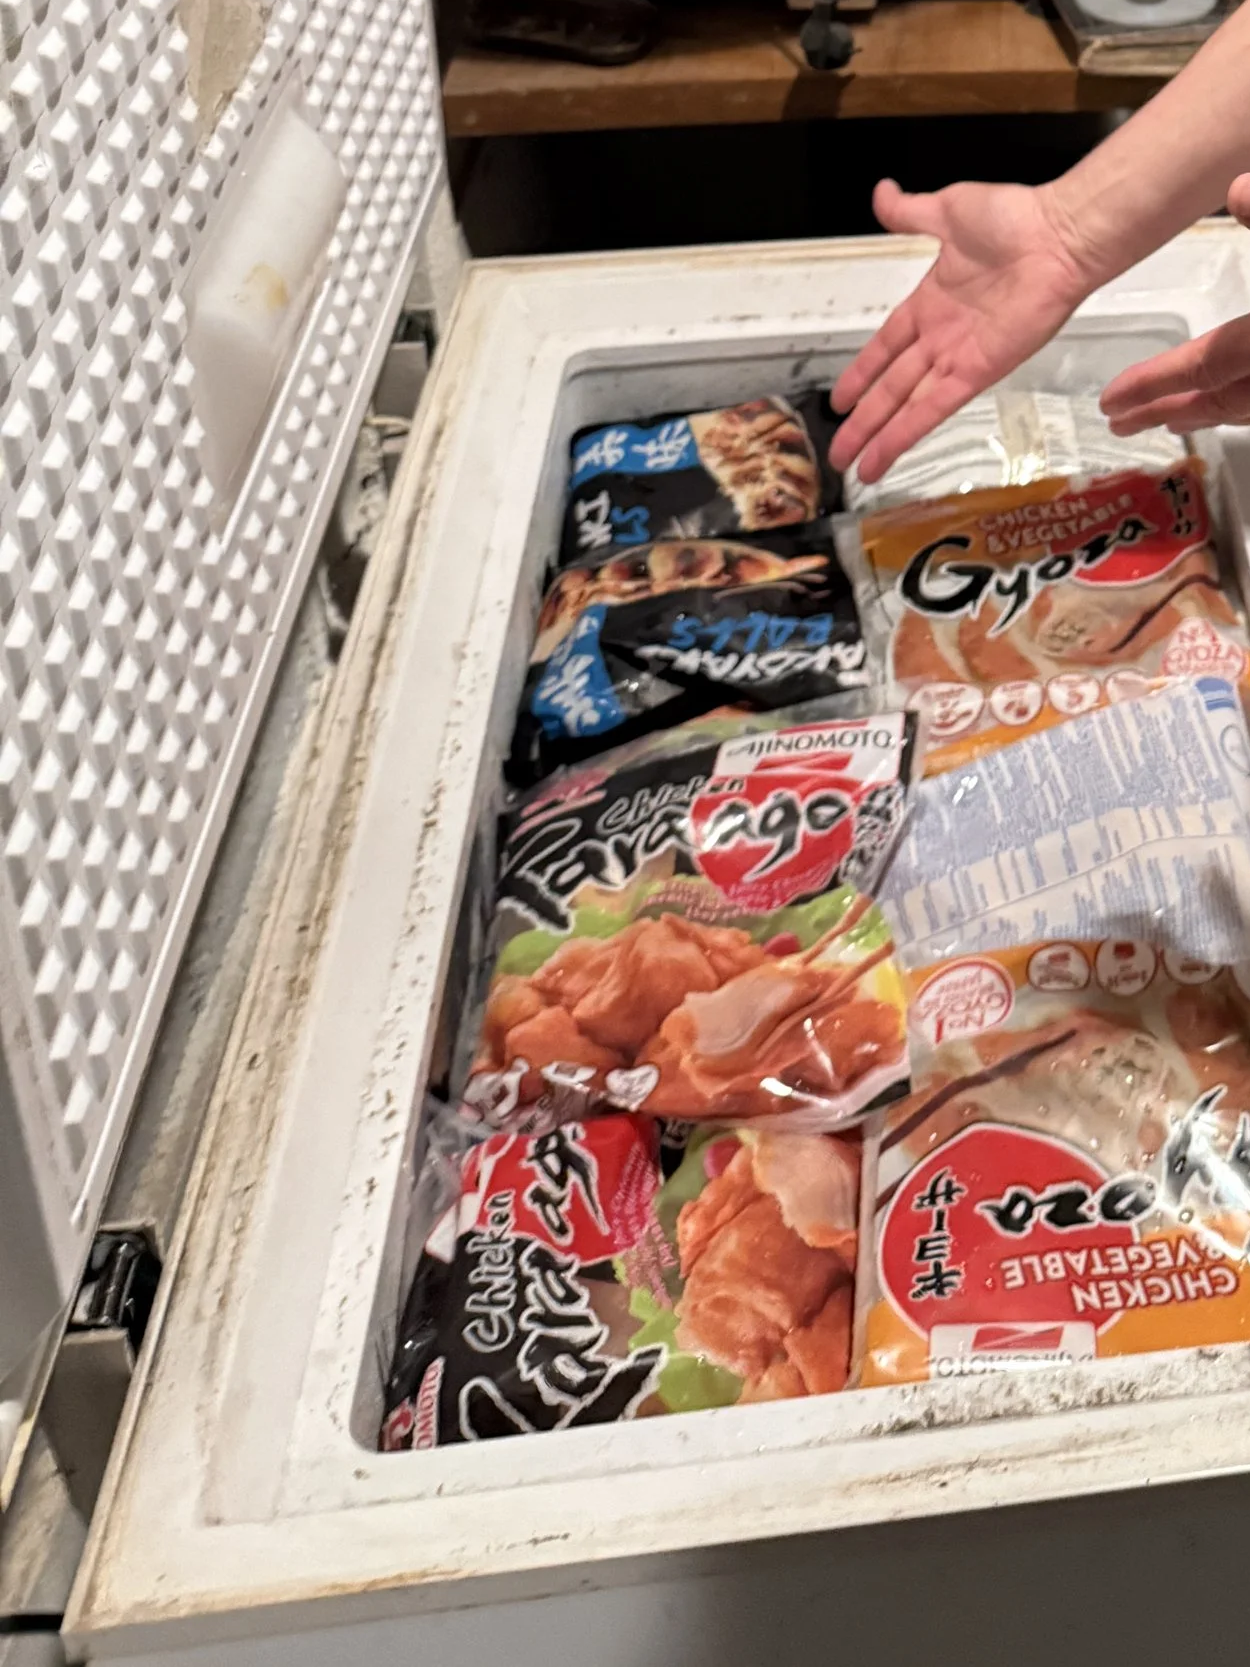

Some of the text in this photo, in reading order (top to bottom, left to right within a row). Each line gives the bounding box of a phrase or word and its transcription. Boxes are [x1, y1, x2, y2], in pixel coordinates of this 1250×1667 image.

[979, 497, 1088, 532] CHICKEN
[900, 516, 1153, 639] Gyoza
[463, 1190, 516, 1353] Chicken
[1070, 1266, 1239, 1313] CHICKEN
